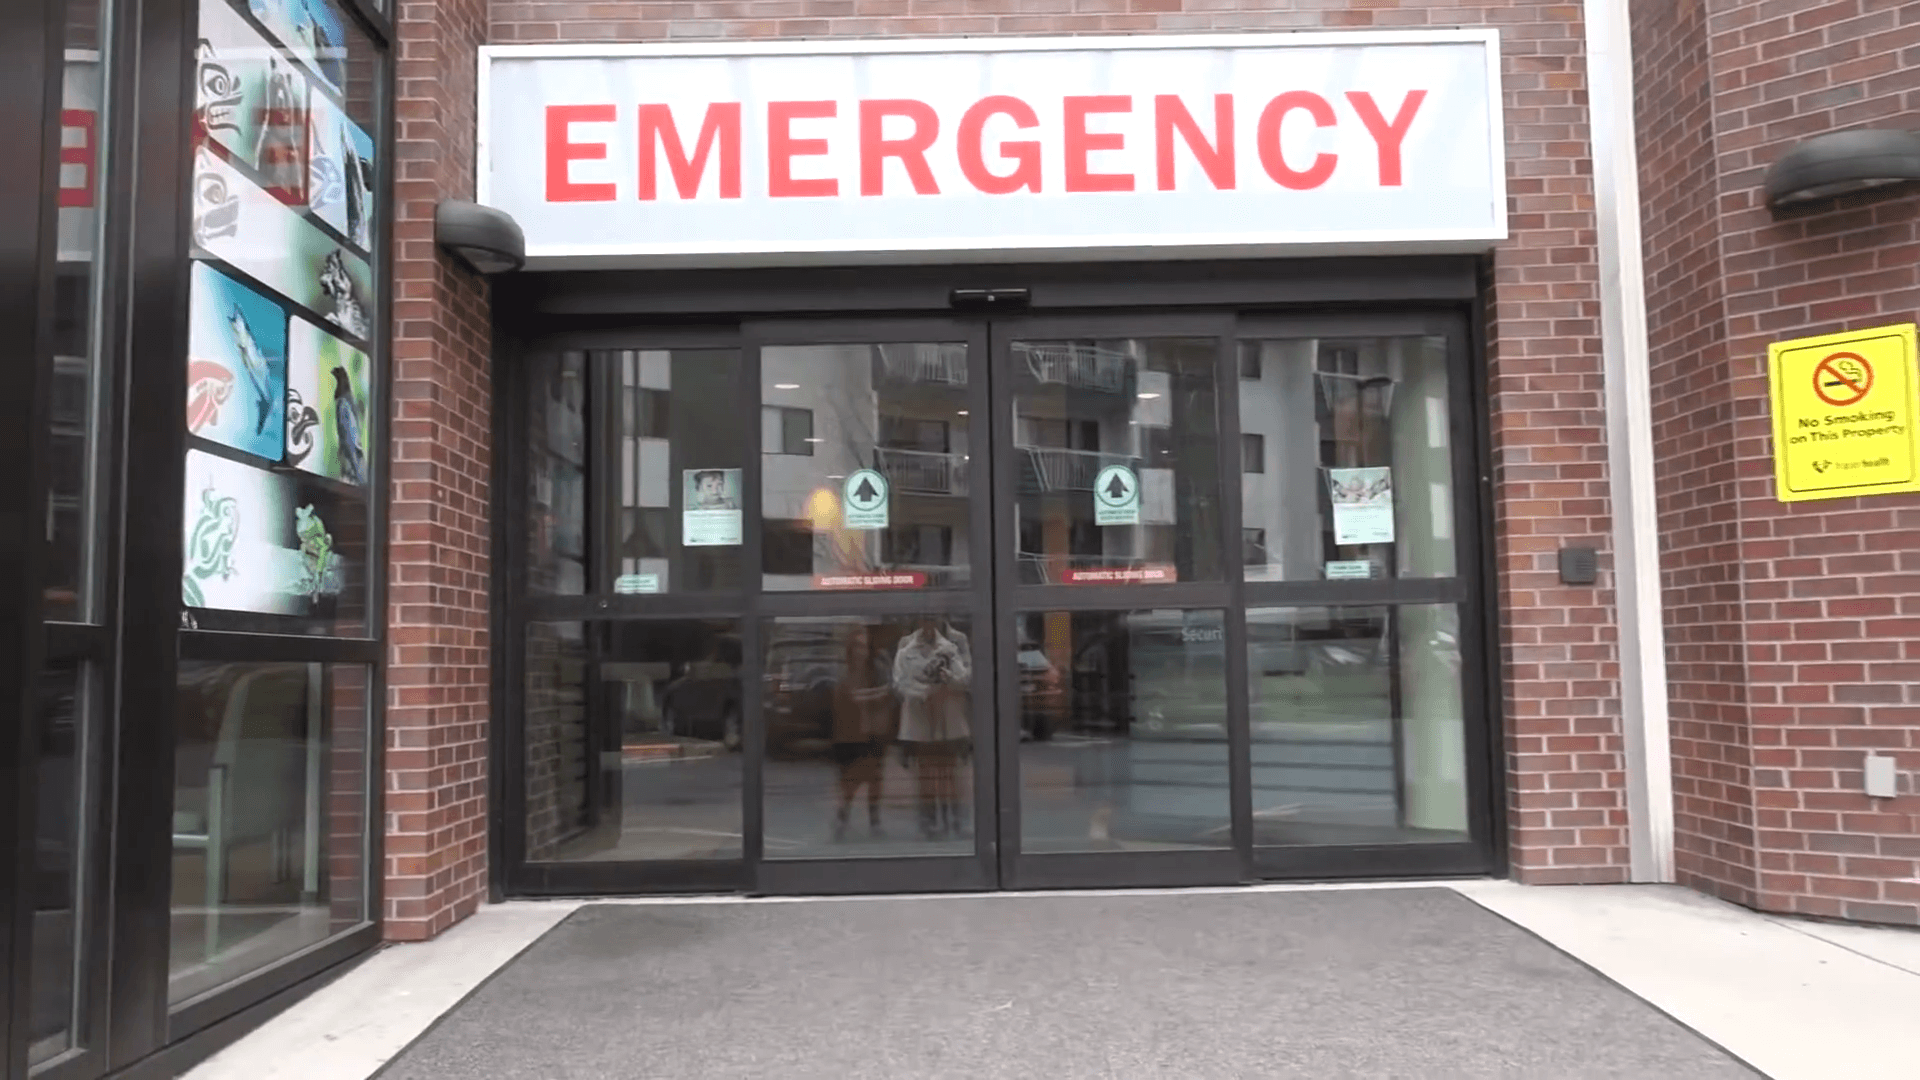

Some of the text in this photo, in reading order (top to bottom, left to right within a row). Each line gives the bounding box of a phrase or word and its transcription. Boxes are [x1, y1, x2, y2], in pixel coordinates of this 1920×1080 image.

[545, 89, 1427, 202] EMERGENCY
[1798, 410, 1896, 429] No Smoking
[1789, 425, 1906, 445] on This Property
[820, 575, 914, 586] AUTOMATIC SLIDING DOOR
[1072, 571, 1113, 581] AUTOMATIC
